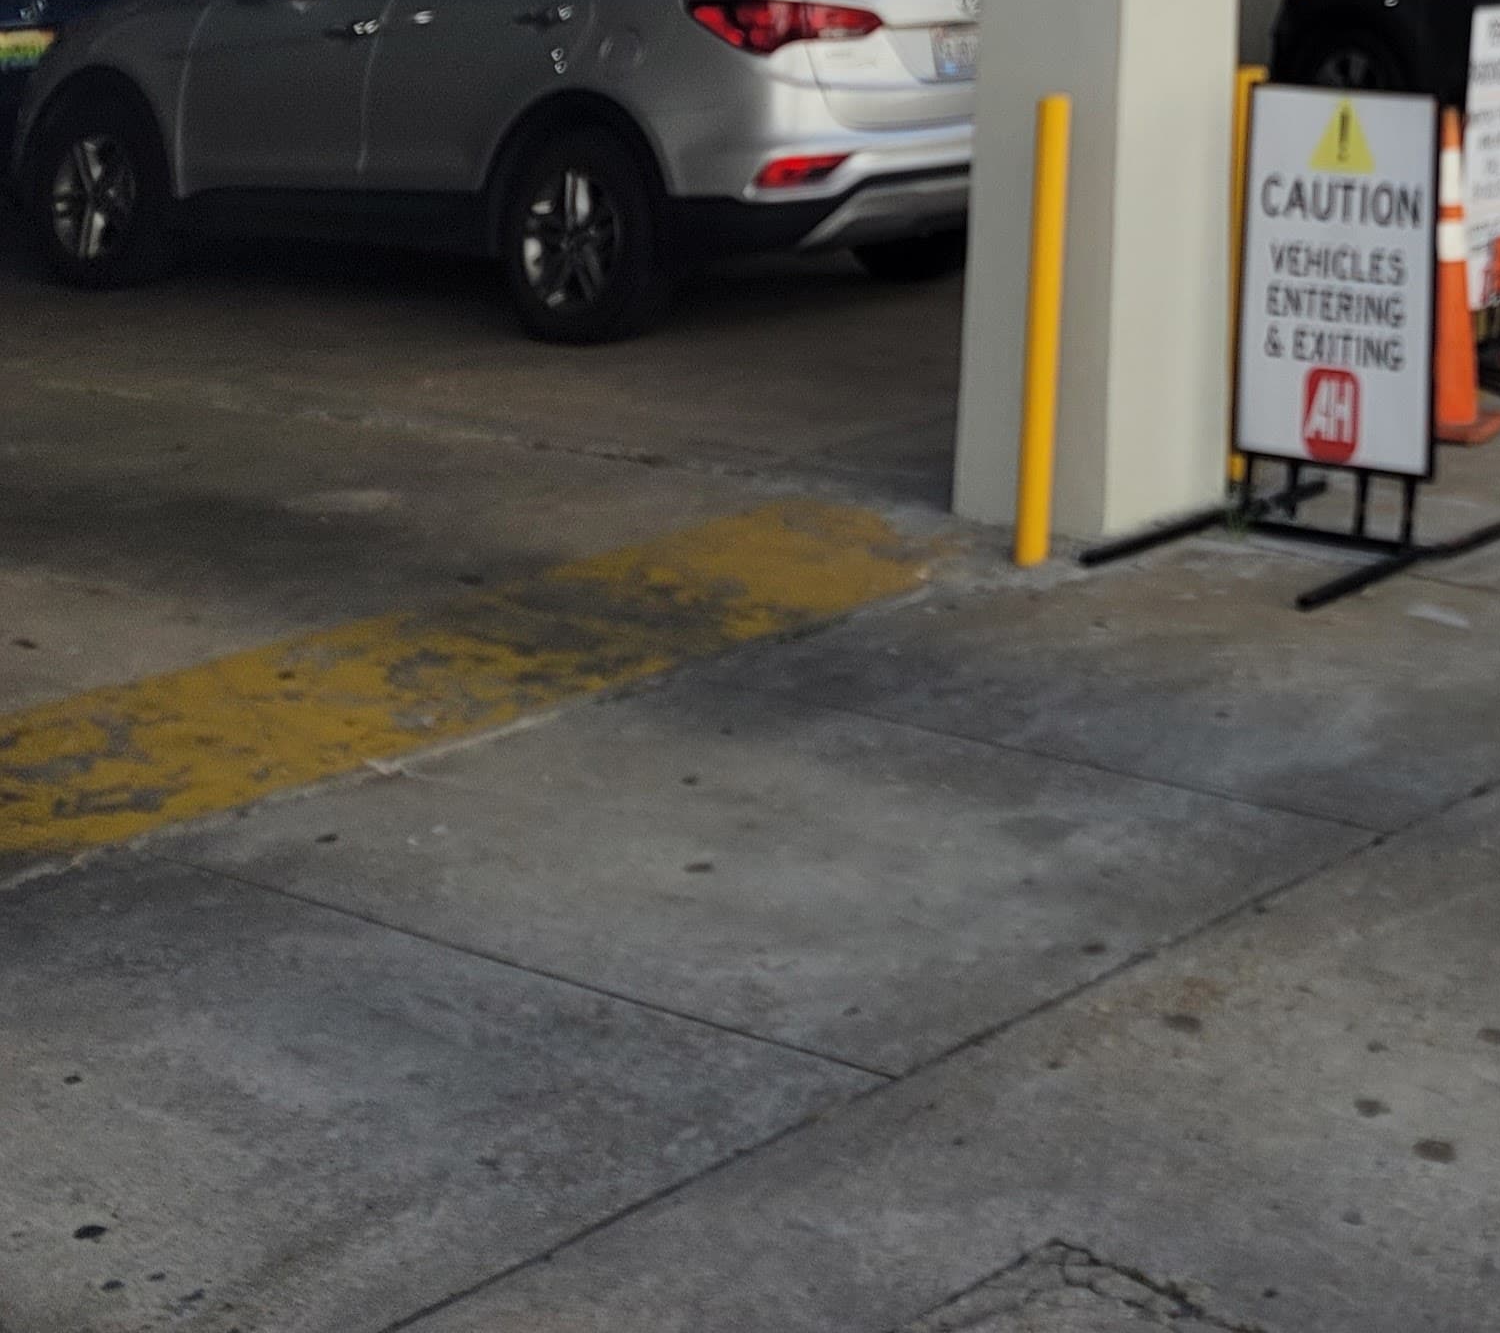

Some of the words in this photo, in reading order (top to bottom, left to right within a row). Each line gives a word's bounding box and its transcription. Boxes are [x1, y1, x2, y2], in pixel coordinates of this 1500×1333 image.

[1260, 173, 1424, 229] CAUTION
[1269, 239, 1408, 286] VEHICLES
[1265, 285, 1407, 329] ENTERING
[1264, 324, 1285, 358] &
[1292, 330, 1406, 371] EXITING
[1304, 376, 1357, 446] AH
